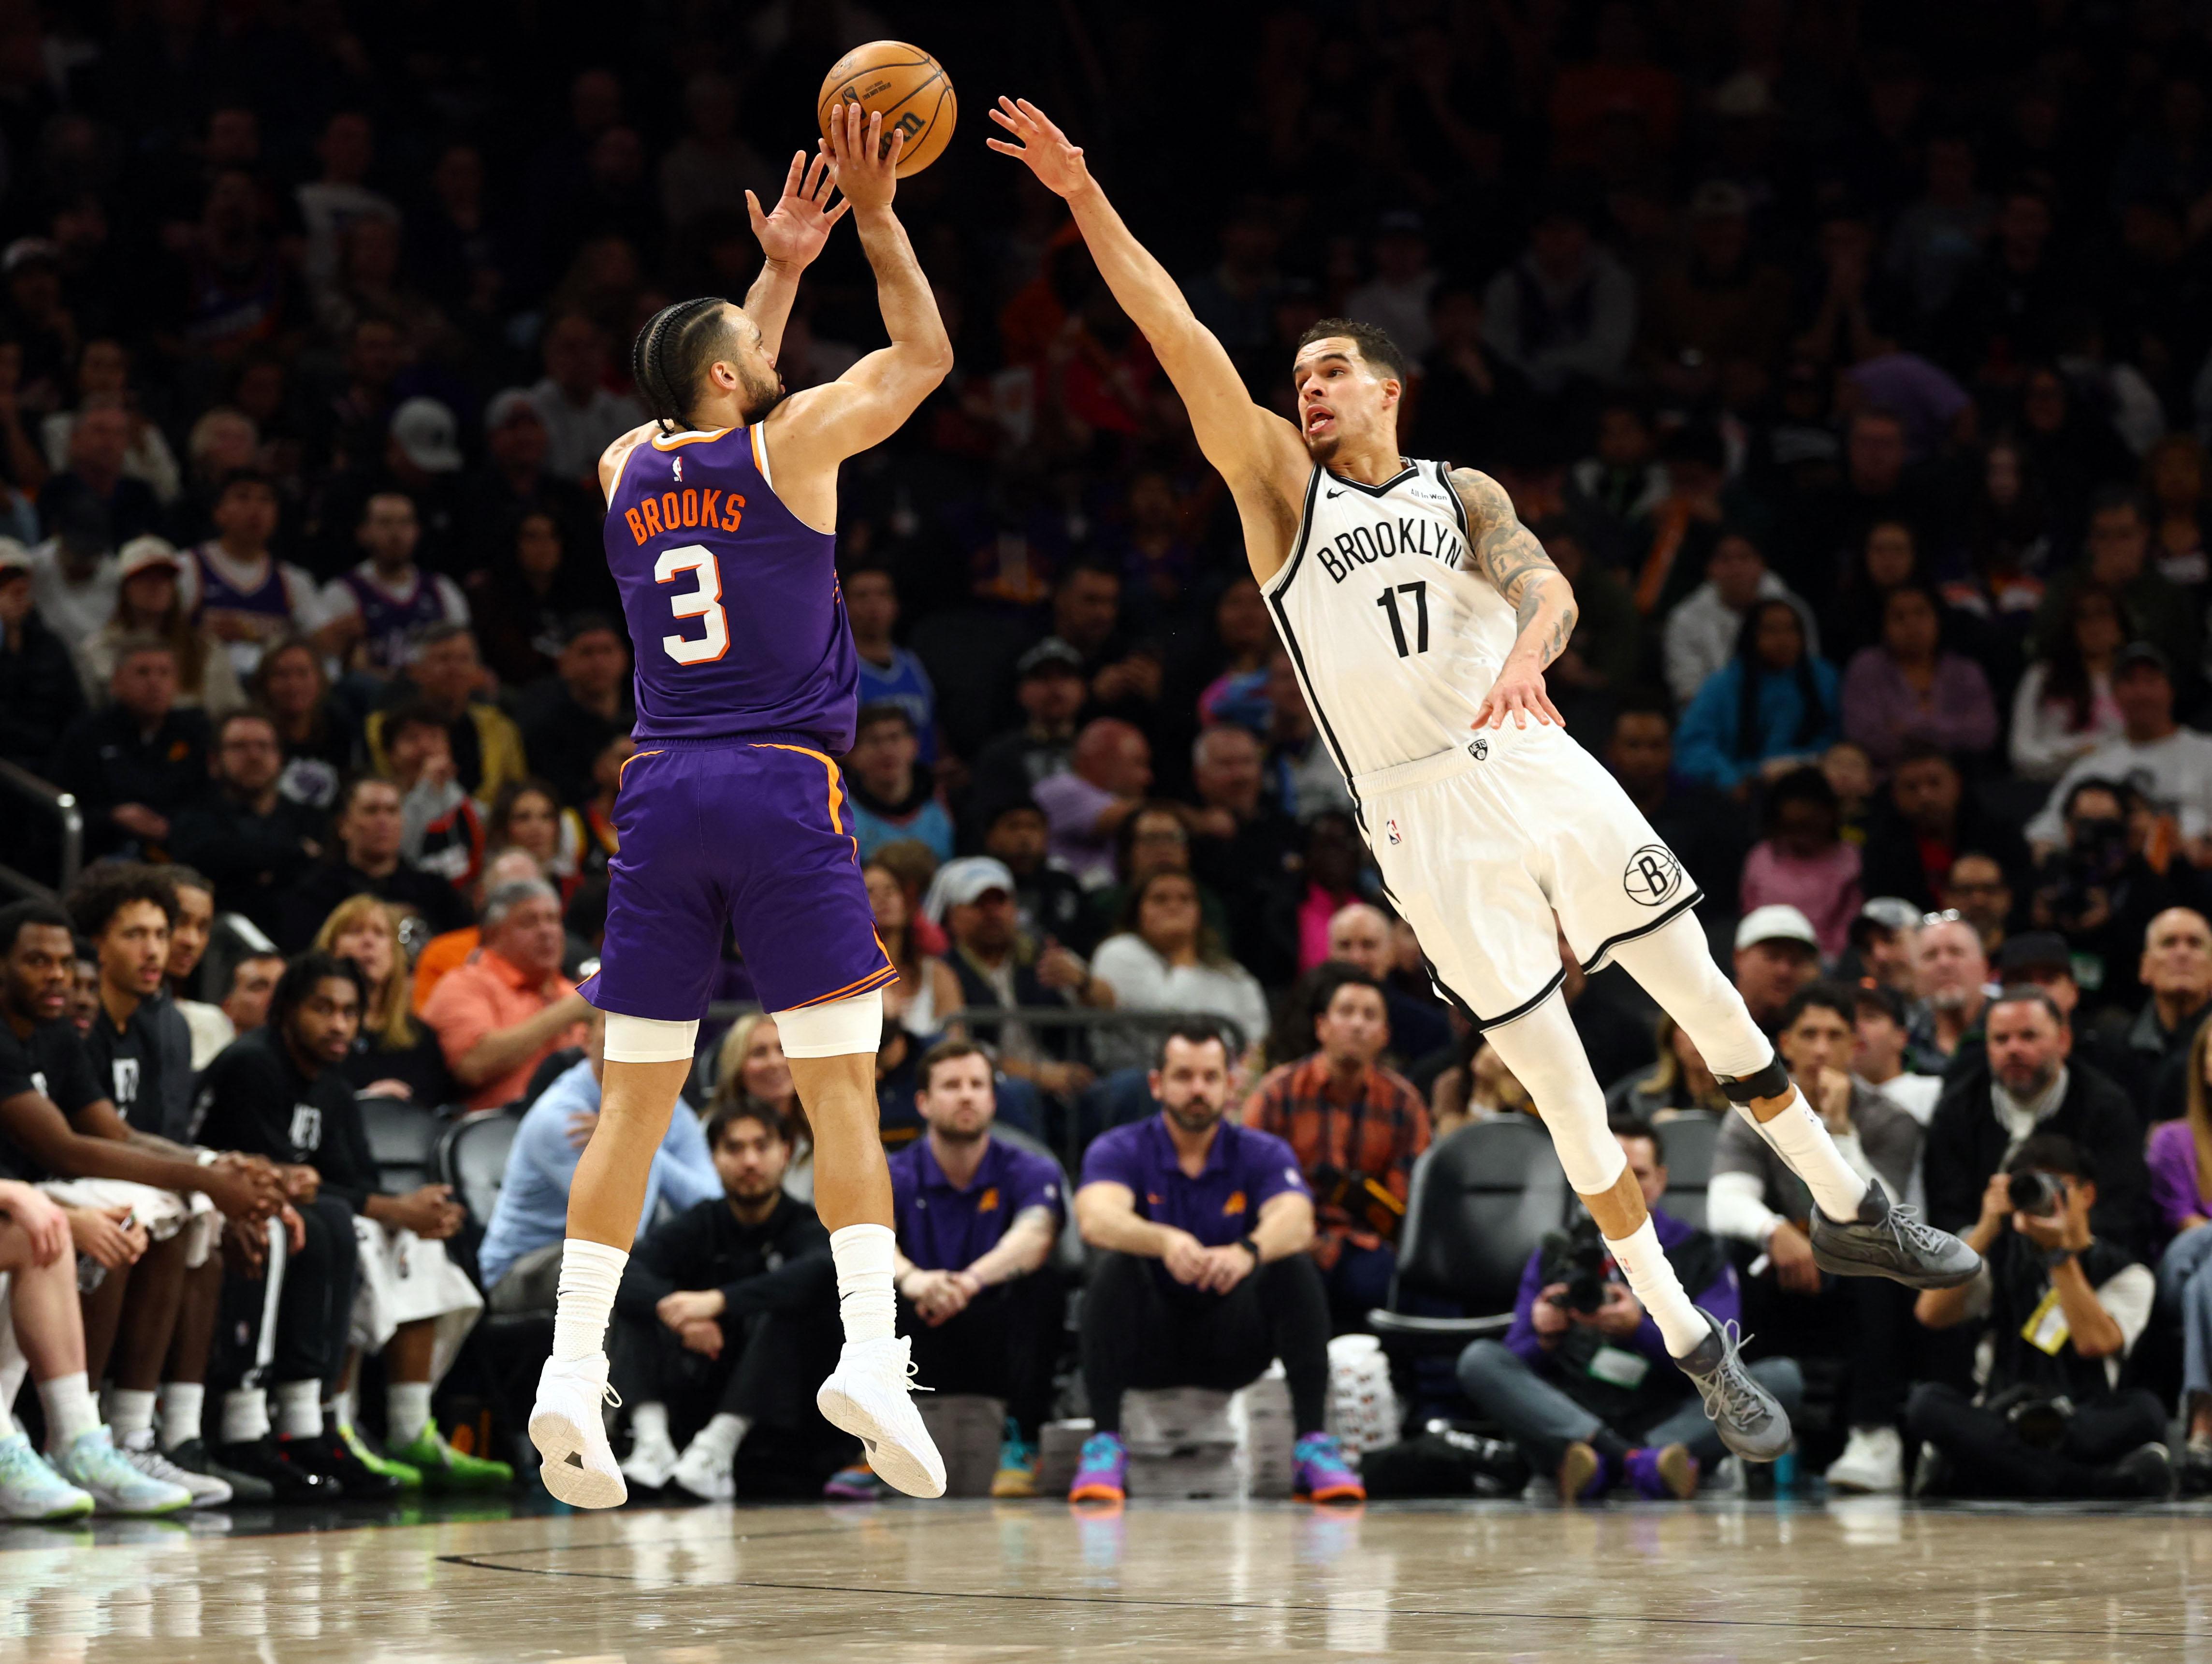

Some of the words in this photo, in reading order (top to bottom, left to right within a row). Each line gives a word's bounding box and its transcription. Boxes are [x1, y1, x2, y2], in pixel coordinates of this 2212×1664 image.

[625, 488, 746, 546] BROOKS
[1411, 488, 1419, 497] All
[1316, 518, 1462, 584] BROOKLYN
[654, 544, 730, 666] 3
[1376, 580, 1428, 658] 17
[1470, 740, 1487, 754] NETS
[1637, 855, 1668, 897] B
